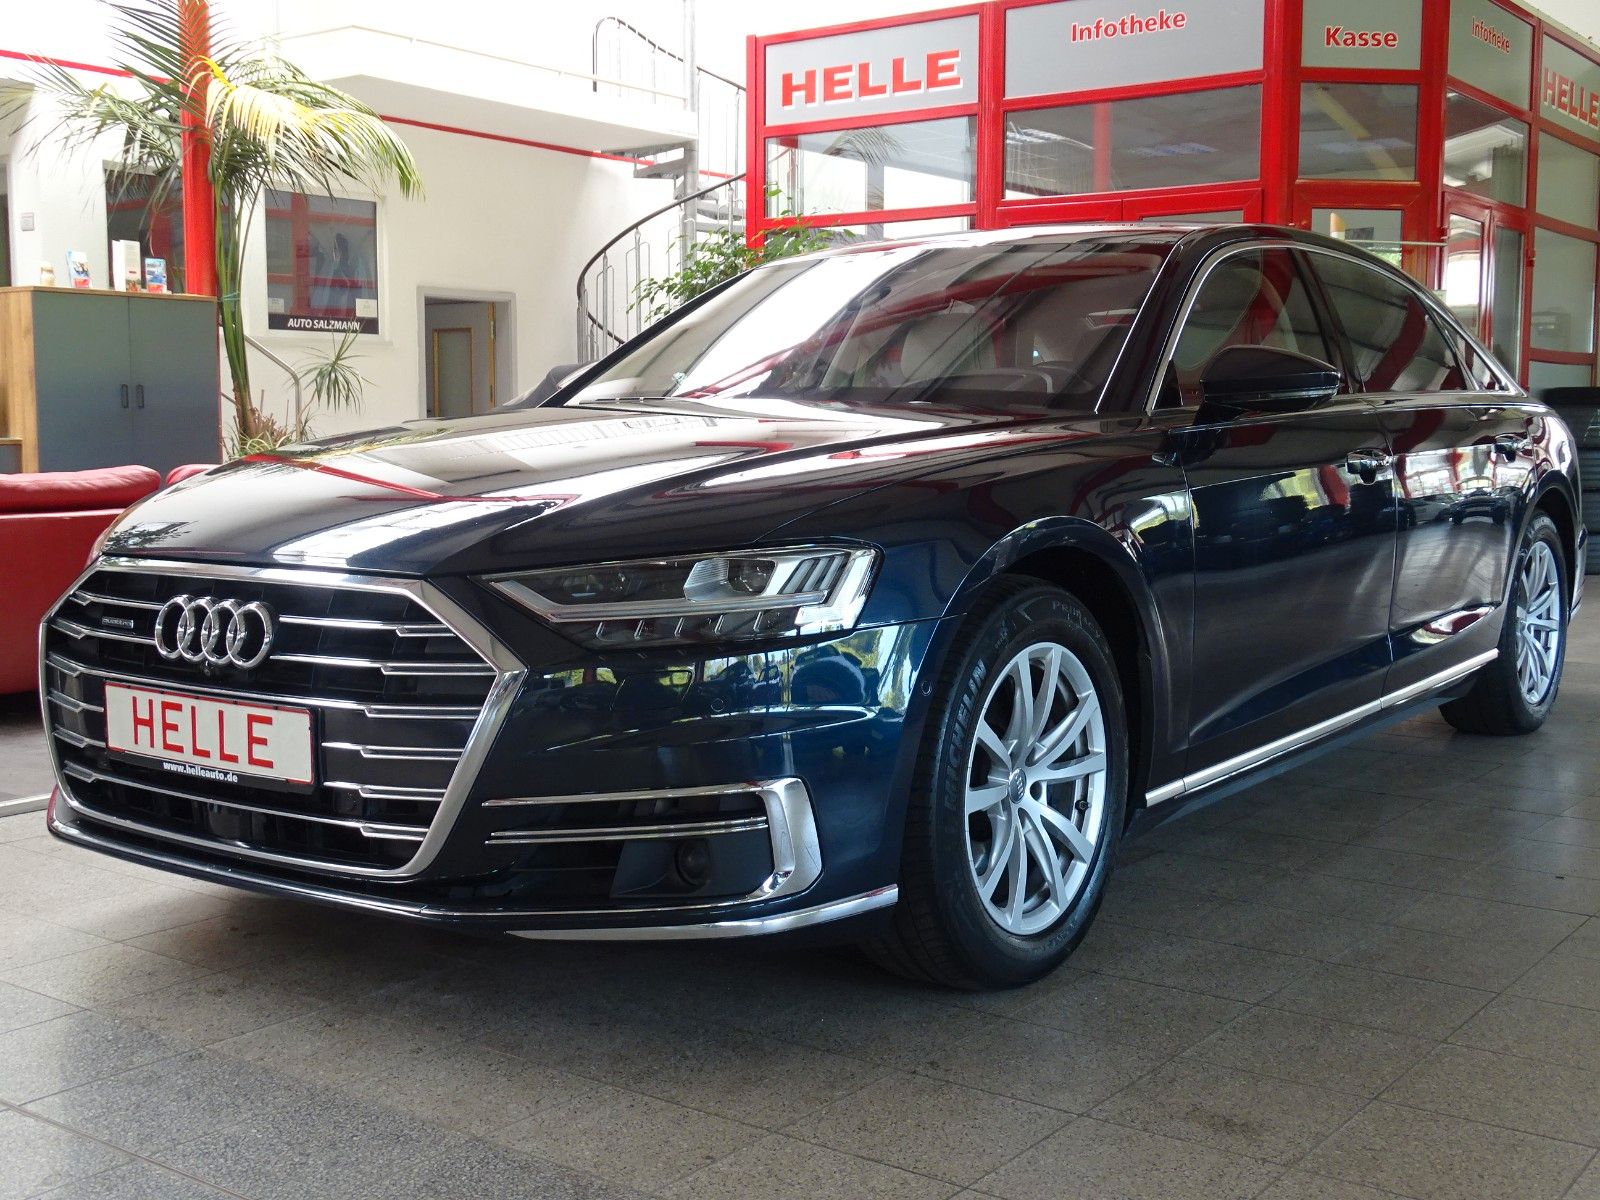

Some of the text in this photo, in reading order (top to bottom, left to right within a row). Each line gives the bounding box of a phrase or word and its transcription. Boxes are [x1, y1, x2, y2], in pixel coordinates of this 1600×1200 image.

[1071, 9, 1188, 43] Infotheke
[1325, 25, 1398, 49] Kasse
[1472, 17, 1511, 54] Infotheke
[781, 49, 963, 110] HELLE
[1543, 67, 1600, 130] HELLE
[287, 318, 360, 331] AUTO SALZMANN
[132, 696, 274, 769] HELLE
[163, 761, 238, 783] www.helleauto.de
